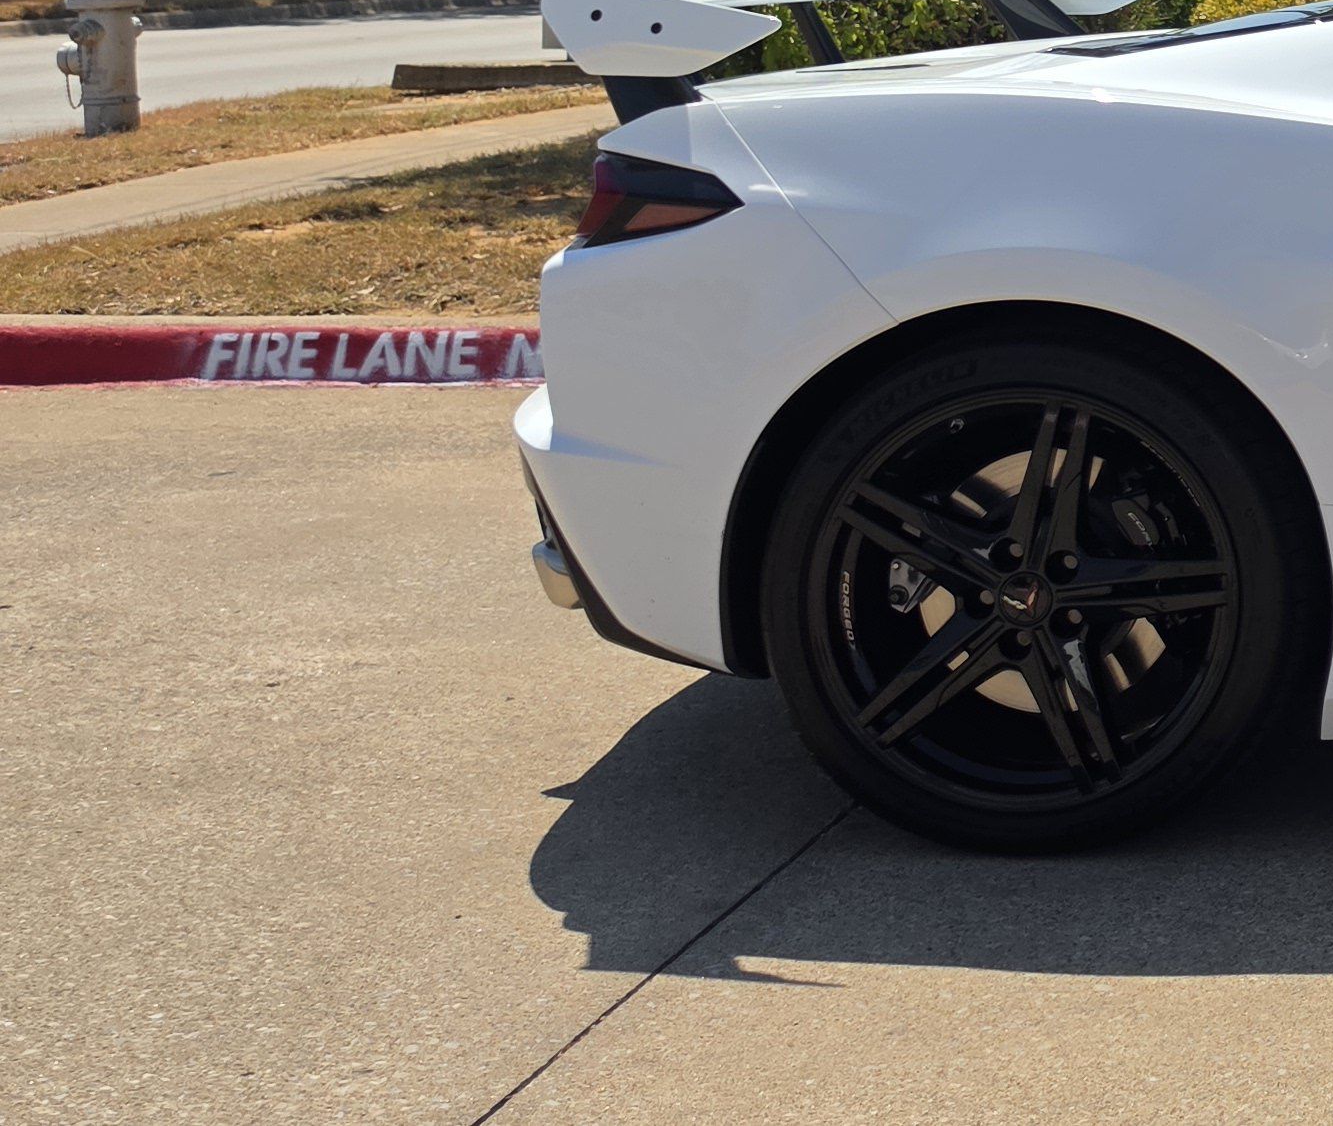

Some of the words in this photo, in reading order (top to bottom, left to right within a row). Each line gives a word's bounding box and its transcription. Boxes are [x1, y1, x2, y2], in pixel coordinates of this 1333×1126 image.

[204, 331, 321, 380] FIRE
[331, 330, 484, 380] LANE
[842, 570, 855, 641] FORGED
